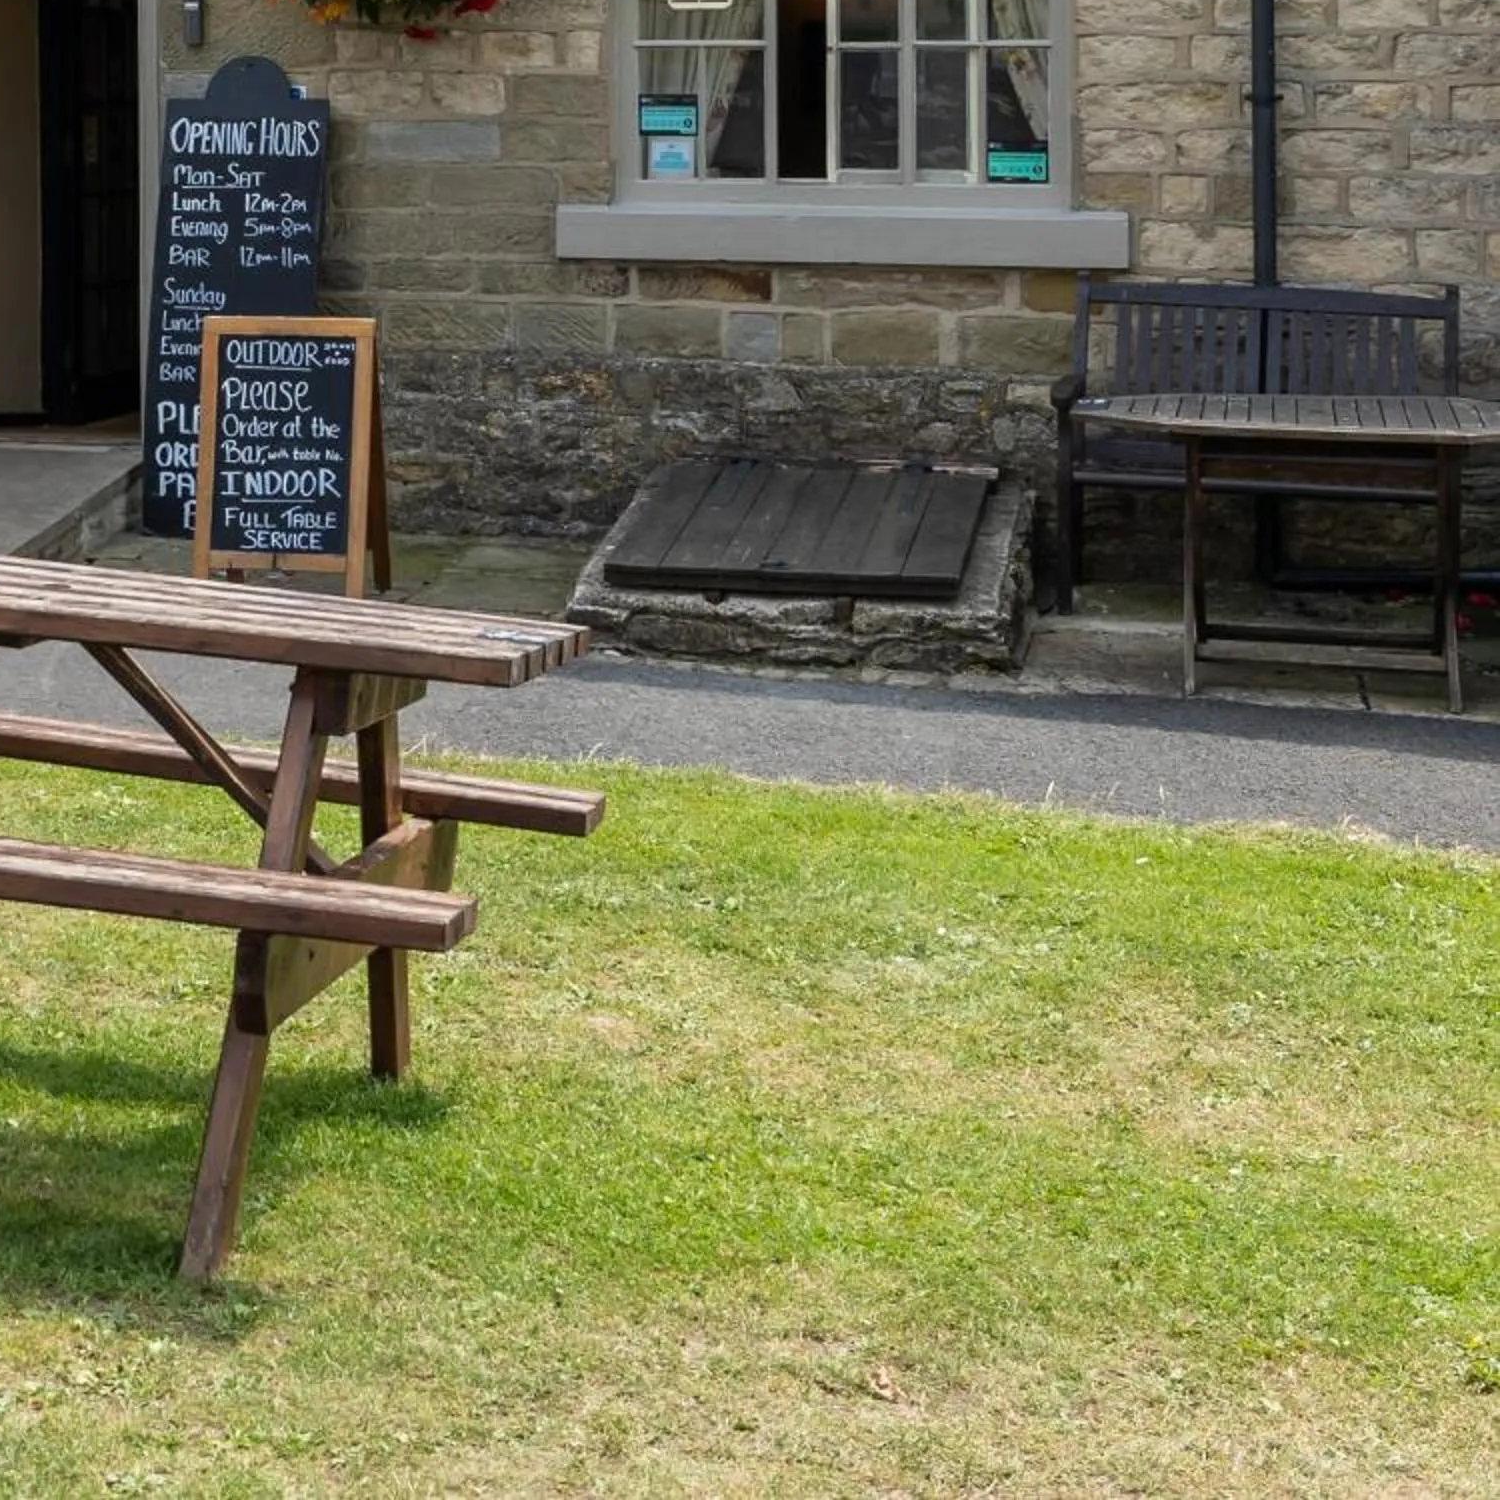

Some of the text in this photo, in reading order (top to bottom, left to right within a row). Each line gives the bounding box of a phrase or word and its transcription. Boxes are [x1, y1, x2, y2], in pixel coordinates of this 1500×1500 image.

[170, 116, 320, 157] OPENING HOURS
[172, 191, 222, 212] Lunch
[168, 244, 211, 266] BAR
[163, 276, 226, 310] Sunday
[226, 339, 324, 367] OUTDOOR
[159, 361, 197, 382] BAR
[222, 413, 341, 439] Order at the
[221, 439, 270, 465] Bar,
[220, 467, 341, 498] INDOOR
[225, 505, 338, 529] FULL TABLE
[239, 529, 324, 550] SERVICE
